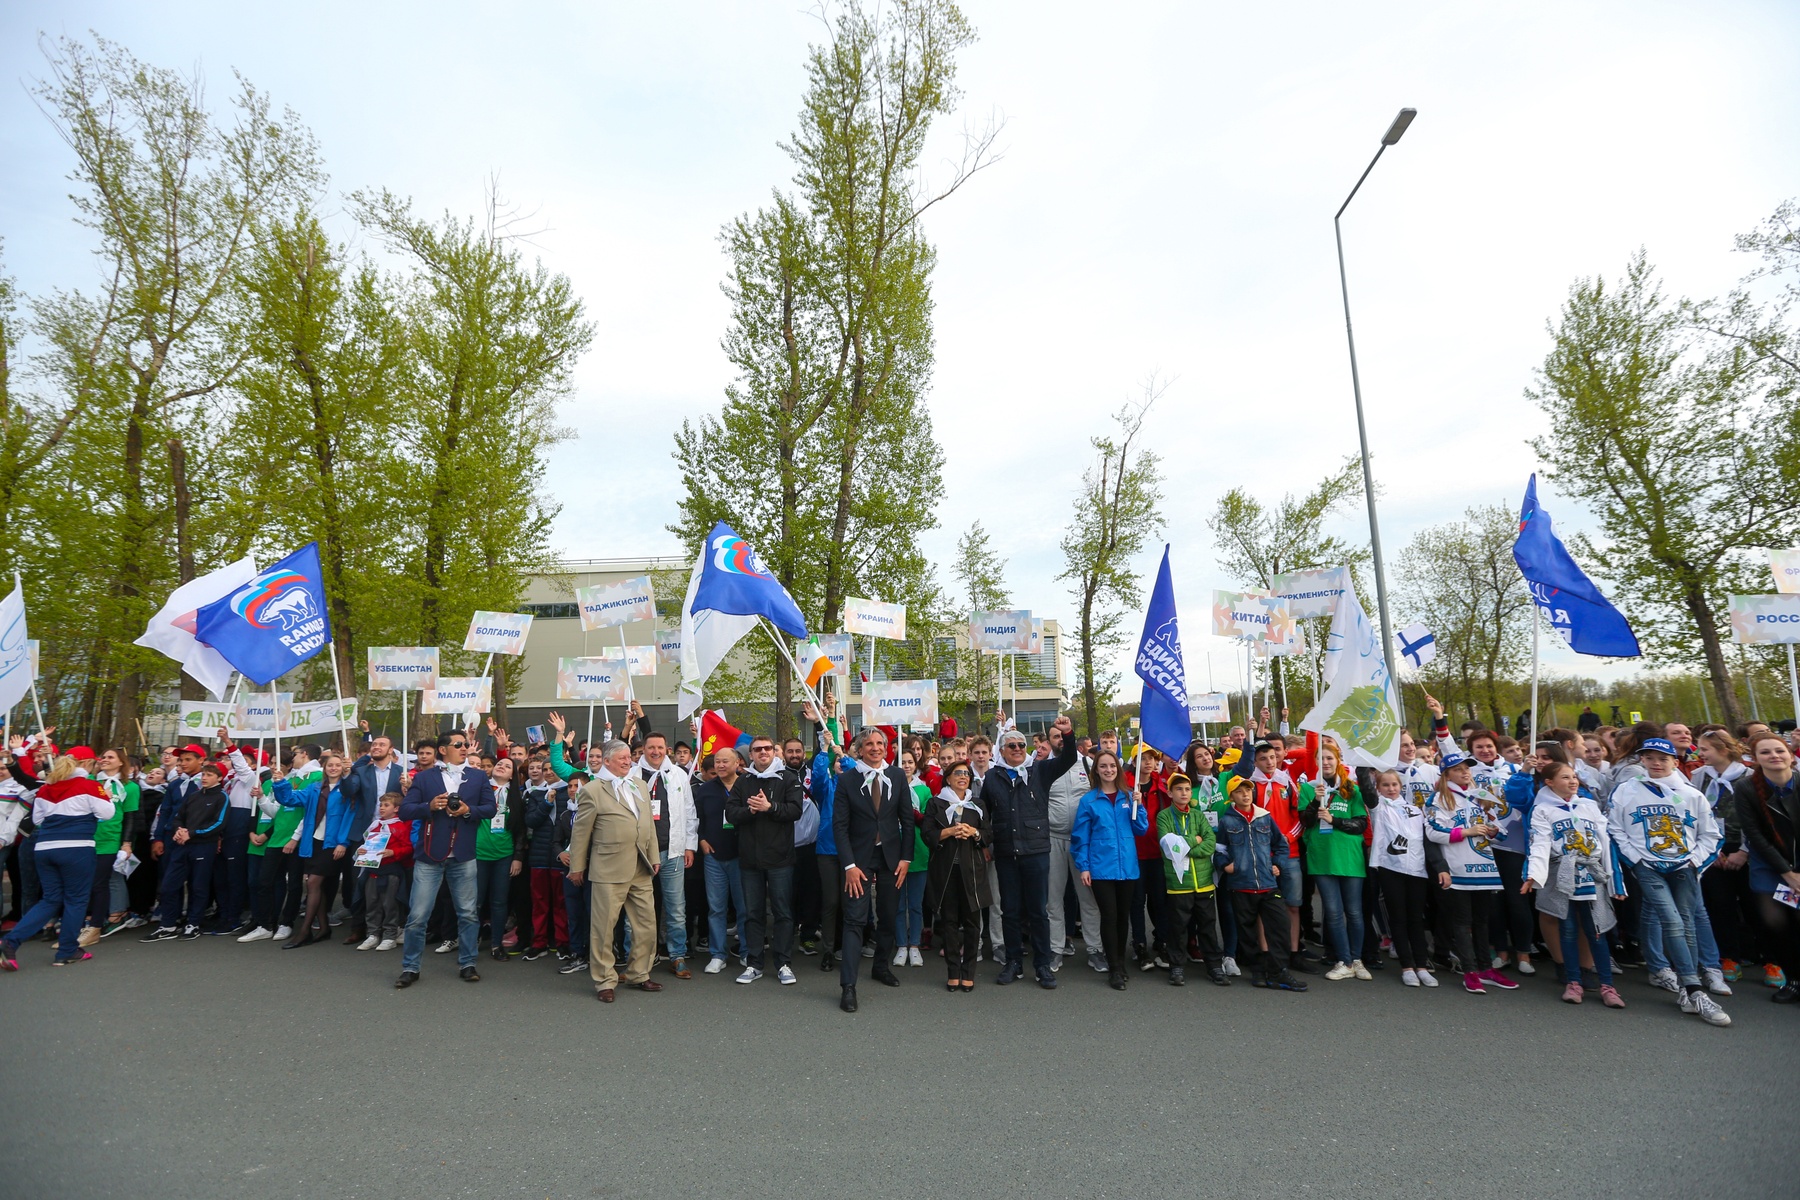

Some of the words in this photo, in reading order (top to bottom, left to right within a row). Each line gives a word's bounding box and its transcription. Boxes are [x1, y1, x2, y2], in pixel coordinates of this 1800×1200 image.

[584, 595, 649, 613] ТАДЖИКИСТАН
[857, 613, 894, 625] УКРАИНА
[1231, 611, 1271, 625] КИТАЙ
[475, 626, 521, 638] БОЛГАРИЯ
[985, 626, 1016, 635] ИНДИЯ
[375, 665, 432, 673] УЗБЕКИСТАН
[576, 674, 611, 683] ТУНИС
[1136, 652, 1189, 708] РОССИЯ
[878, 698, 921, 708] ЛАТВИЯ
[1556, 819, 1598, 832] SUMI
